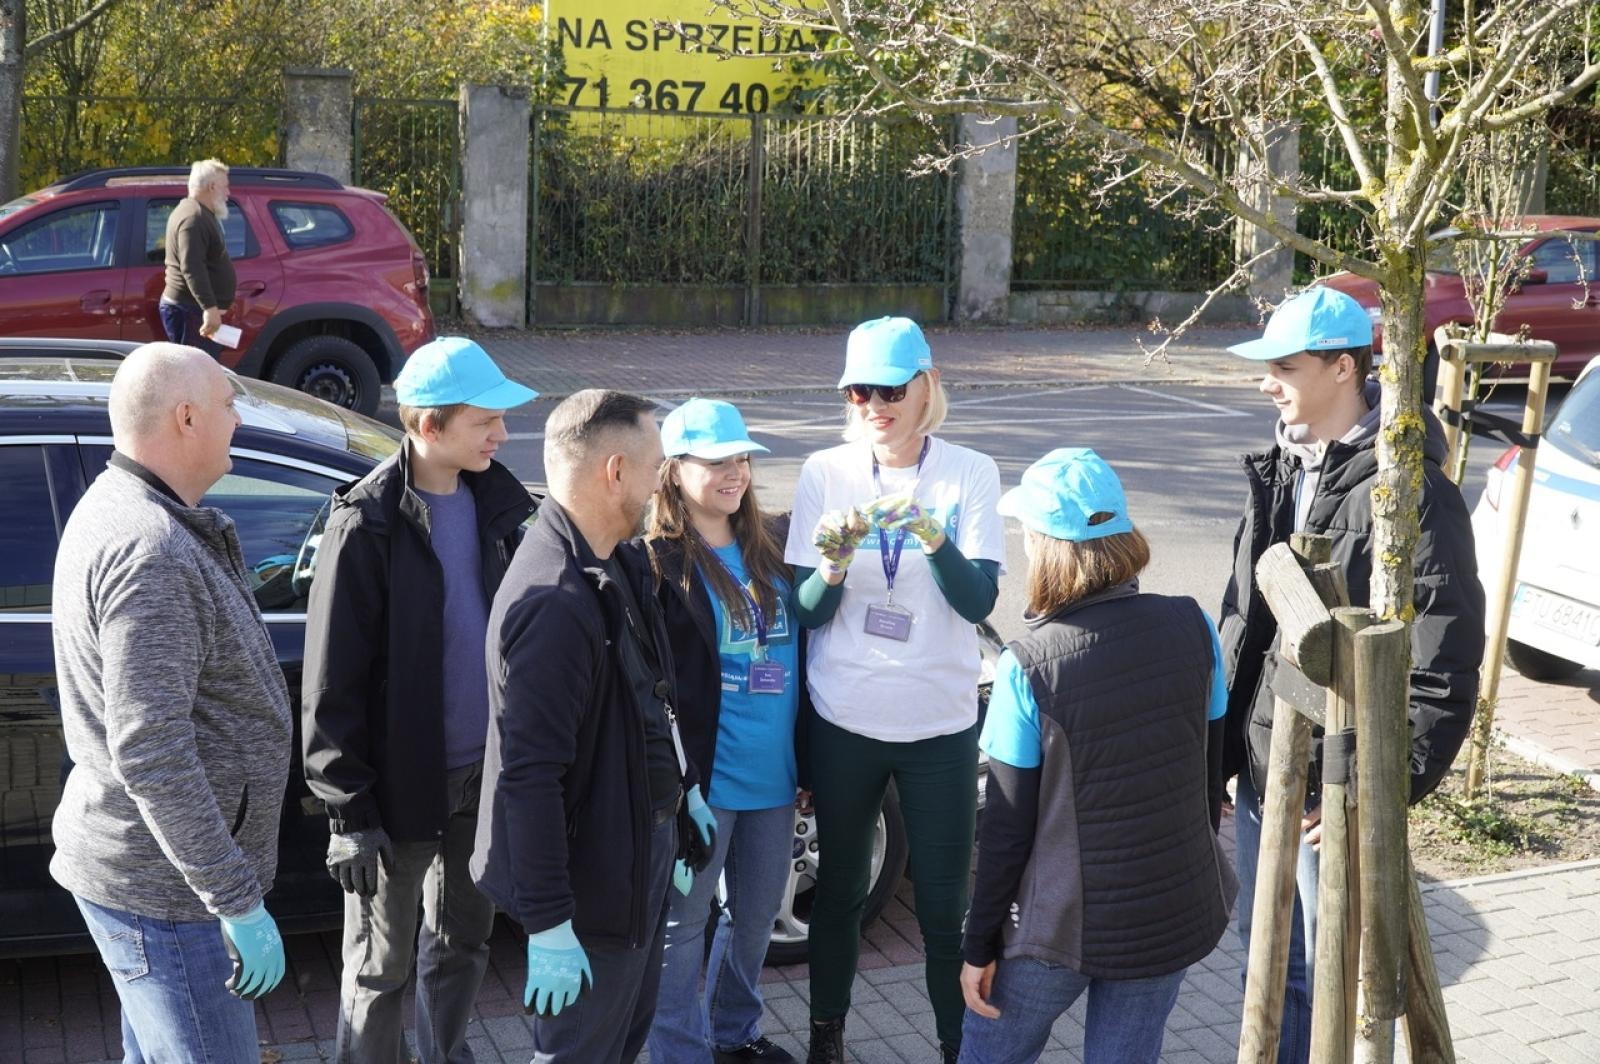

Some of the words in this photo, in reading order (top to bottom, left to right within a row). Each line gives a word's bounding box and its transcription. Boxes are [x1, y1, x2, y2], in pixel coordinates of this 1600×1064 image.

[558, 17, 612, 50] NA
[564, 77, 608, 108] 71
[630, 79, 706, 111] 367
[720, 83, 769, 114] 40
